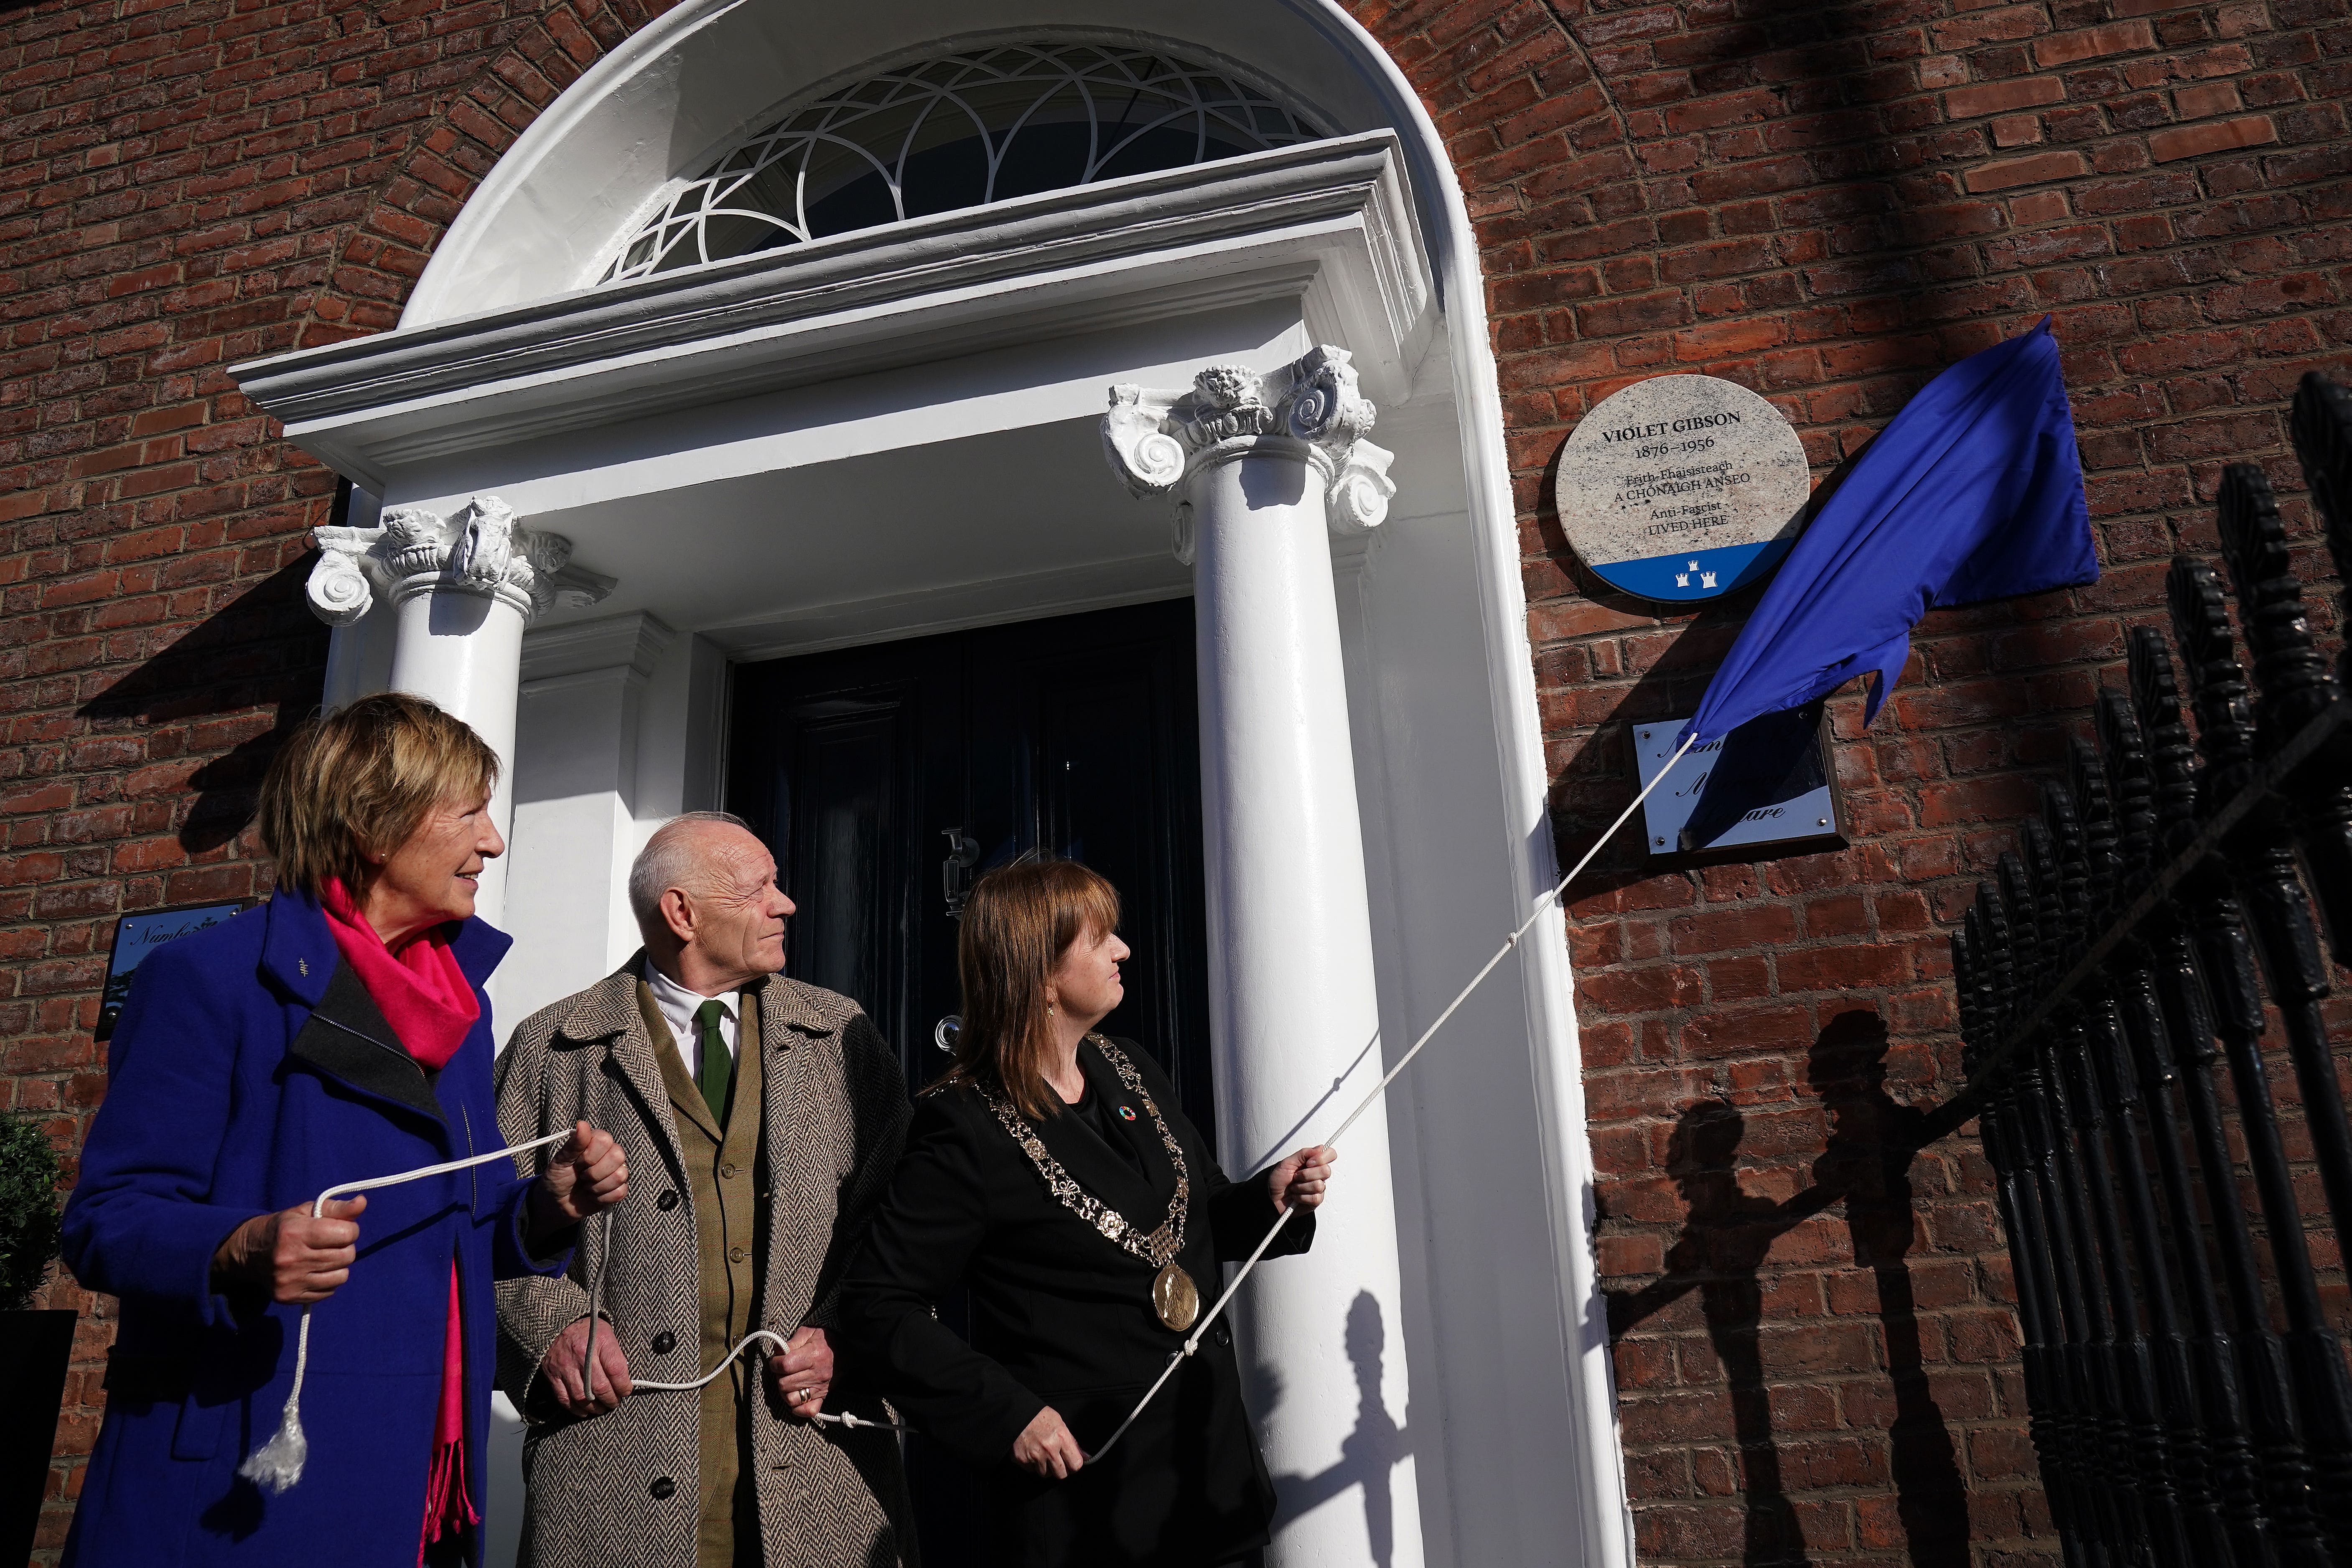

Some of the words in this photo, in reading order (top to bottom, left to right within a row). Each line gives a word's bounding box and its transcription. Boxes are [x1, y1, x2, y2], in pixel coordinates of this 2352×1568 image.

[1602, 423, 1667, 443] VIOLET
[1673, 411, 1741, 433] GIBSON
[1626, 460, 1733, 485] Frith-Fhaisisteach
[1614, 493, 1624, 502] A
[1705, 473, 1750, 489] ANSEO
[1650, 501, 1722, 519] Anti-Fascist
[1648, 521, 1688, 535] LIVED
[1692, 515, 1728, 529] HERE
